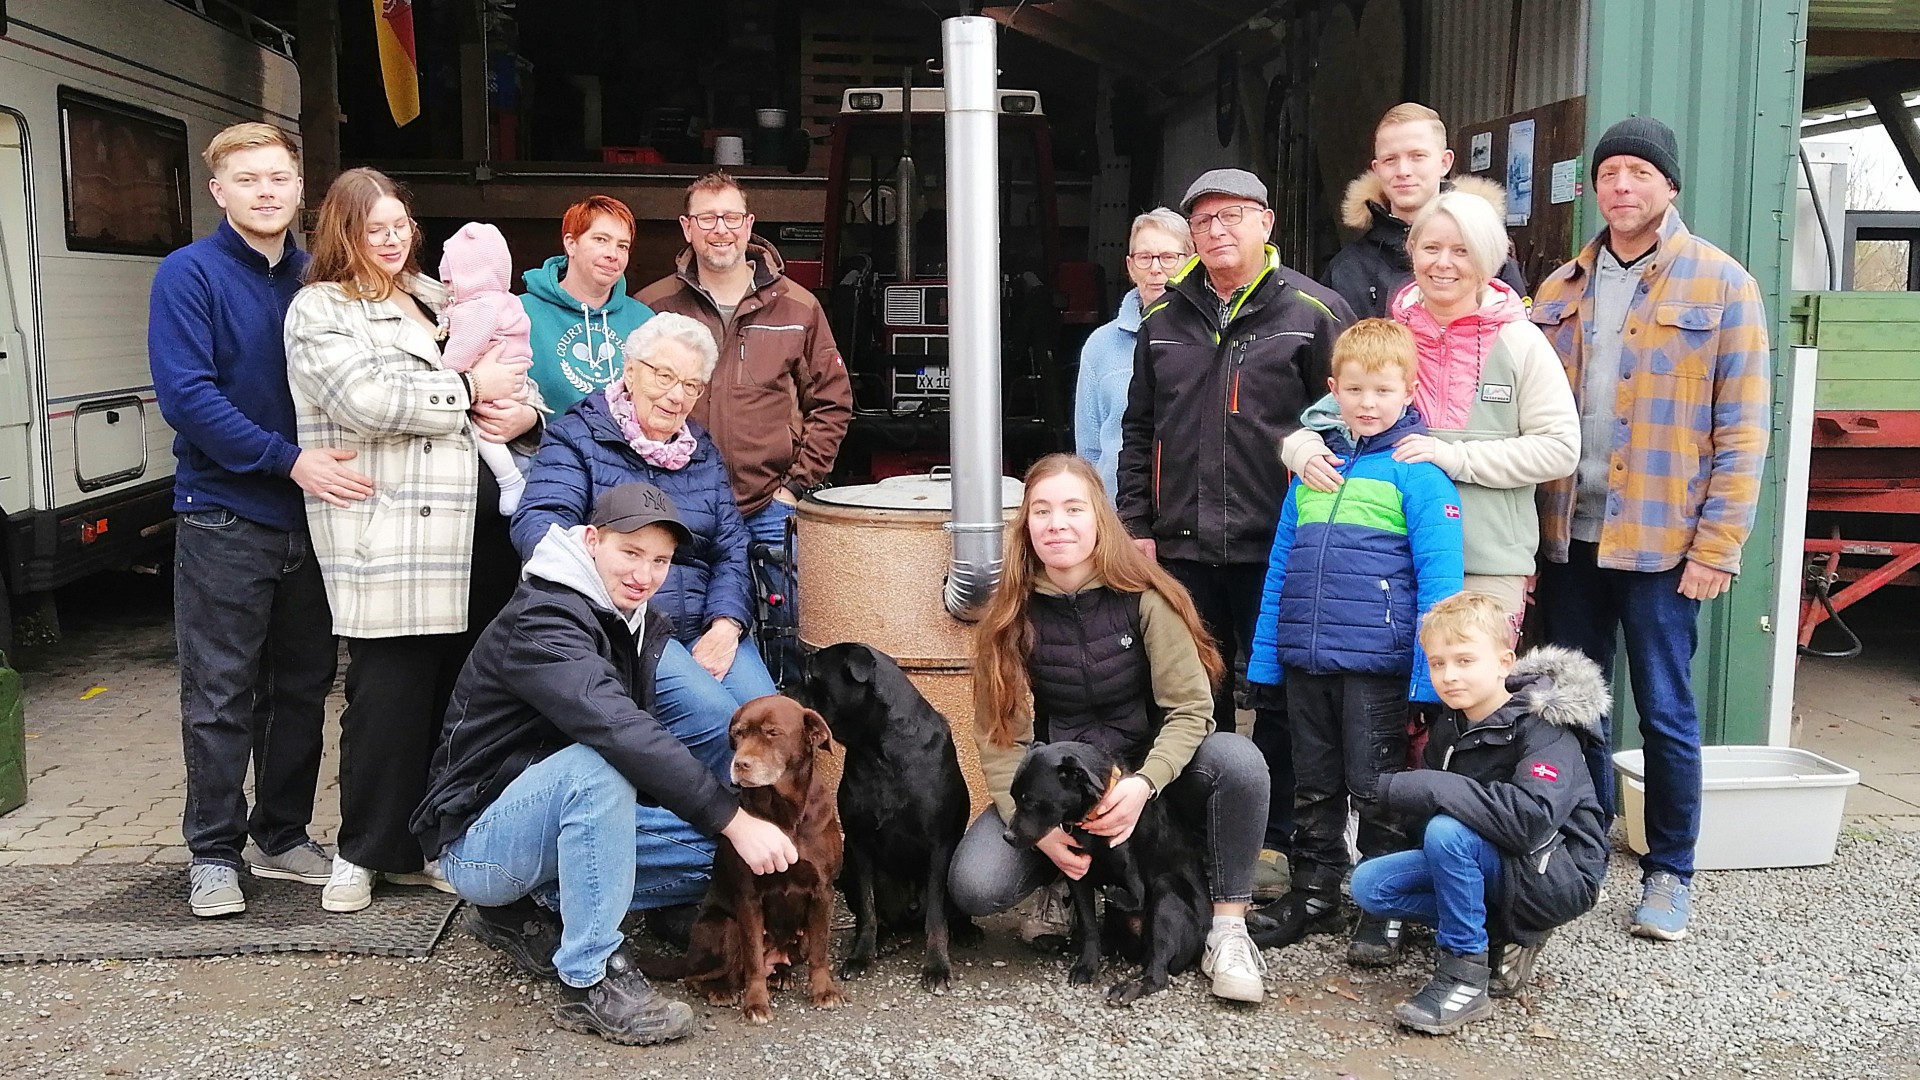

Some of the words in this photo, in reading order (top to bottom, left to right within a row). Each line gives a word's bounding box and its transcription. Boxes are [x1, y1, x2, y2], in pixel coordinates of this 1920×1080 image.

[556, 323, 583, 357] COURT
[939, 366, 947, 377] H
[918, 377, 934, 388] XX
[642, 490, 667, 512] NY
